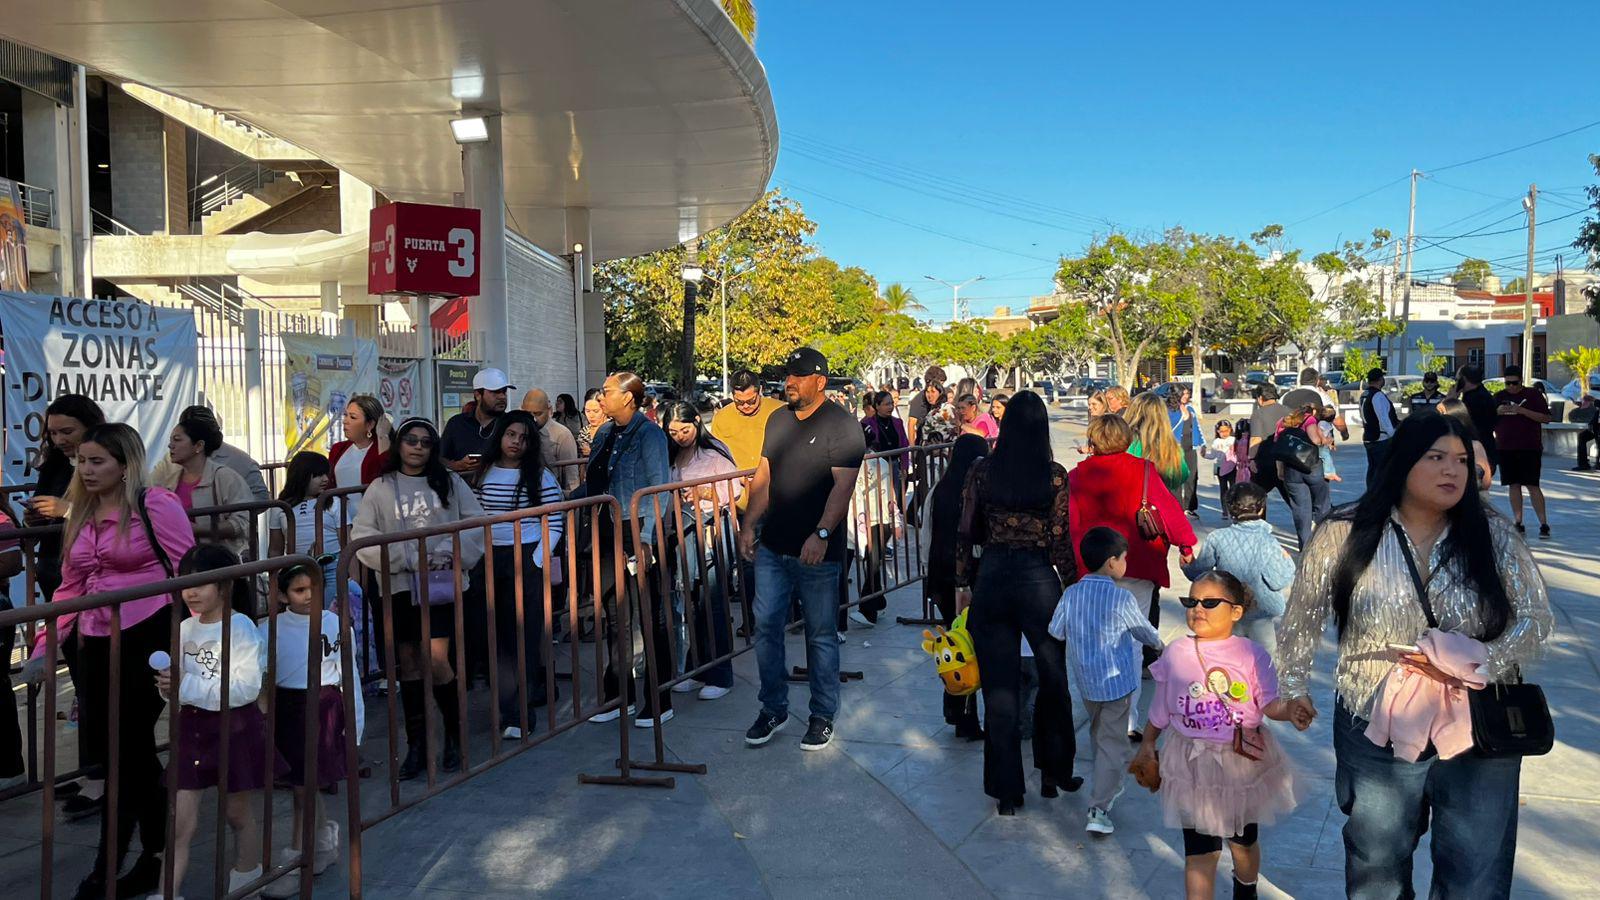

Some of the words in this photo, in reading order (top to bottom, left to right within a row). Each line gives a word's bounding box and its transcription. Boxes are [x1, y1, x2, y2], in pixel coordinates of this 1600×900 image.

[385, 224, 395, 274] 3
[404, 237, 446, 252] PUERTA
[448, 228, 475, 277] 3
[50, 297, 142, 331] ACCESO
[147, 299, 160, 333] A
[62, 332, 159, 370] ZONAS
